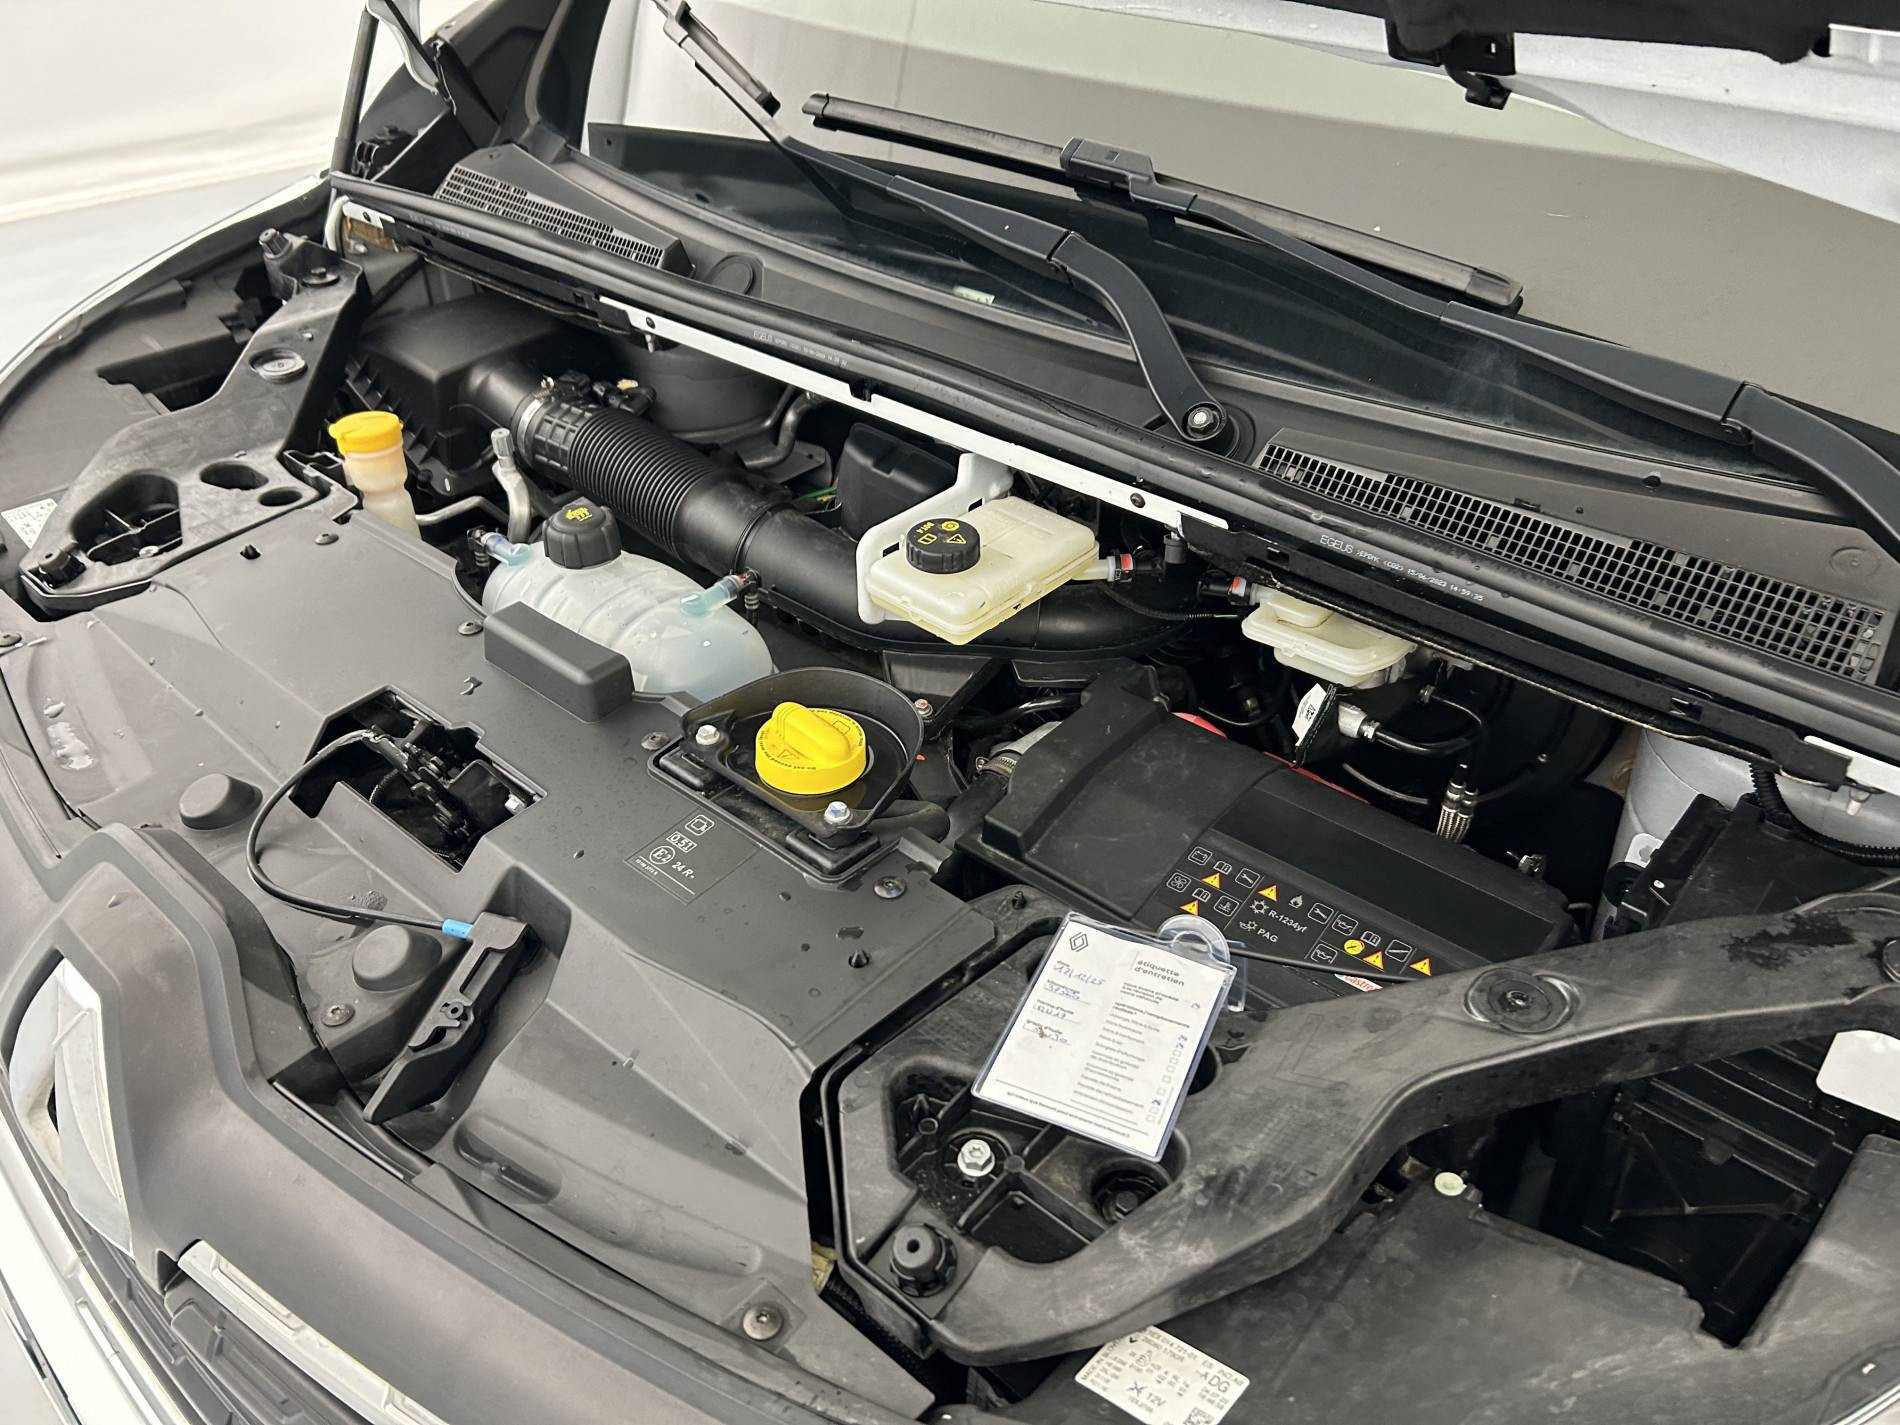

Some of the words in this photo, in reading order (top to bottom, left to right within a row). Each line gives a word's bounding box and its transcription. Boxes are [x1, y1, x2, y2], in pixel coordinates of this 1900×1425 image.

[1320, 534, 1354, 554] EGEUS
[653, 848, 671, 862] E2
[1268, 909, 1307, 934] R-1234yf
[1257, 928, 1278, 943] PAG
[1133, 965, 1186, 986] d'entretien
[1136, 958, 1180, 977] étiquette
[1207, 1375, 1230, 1392] DG
